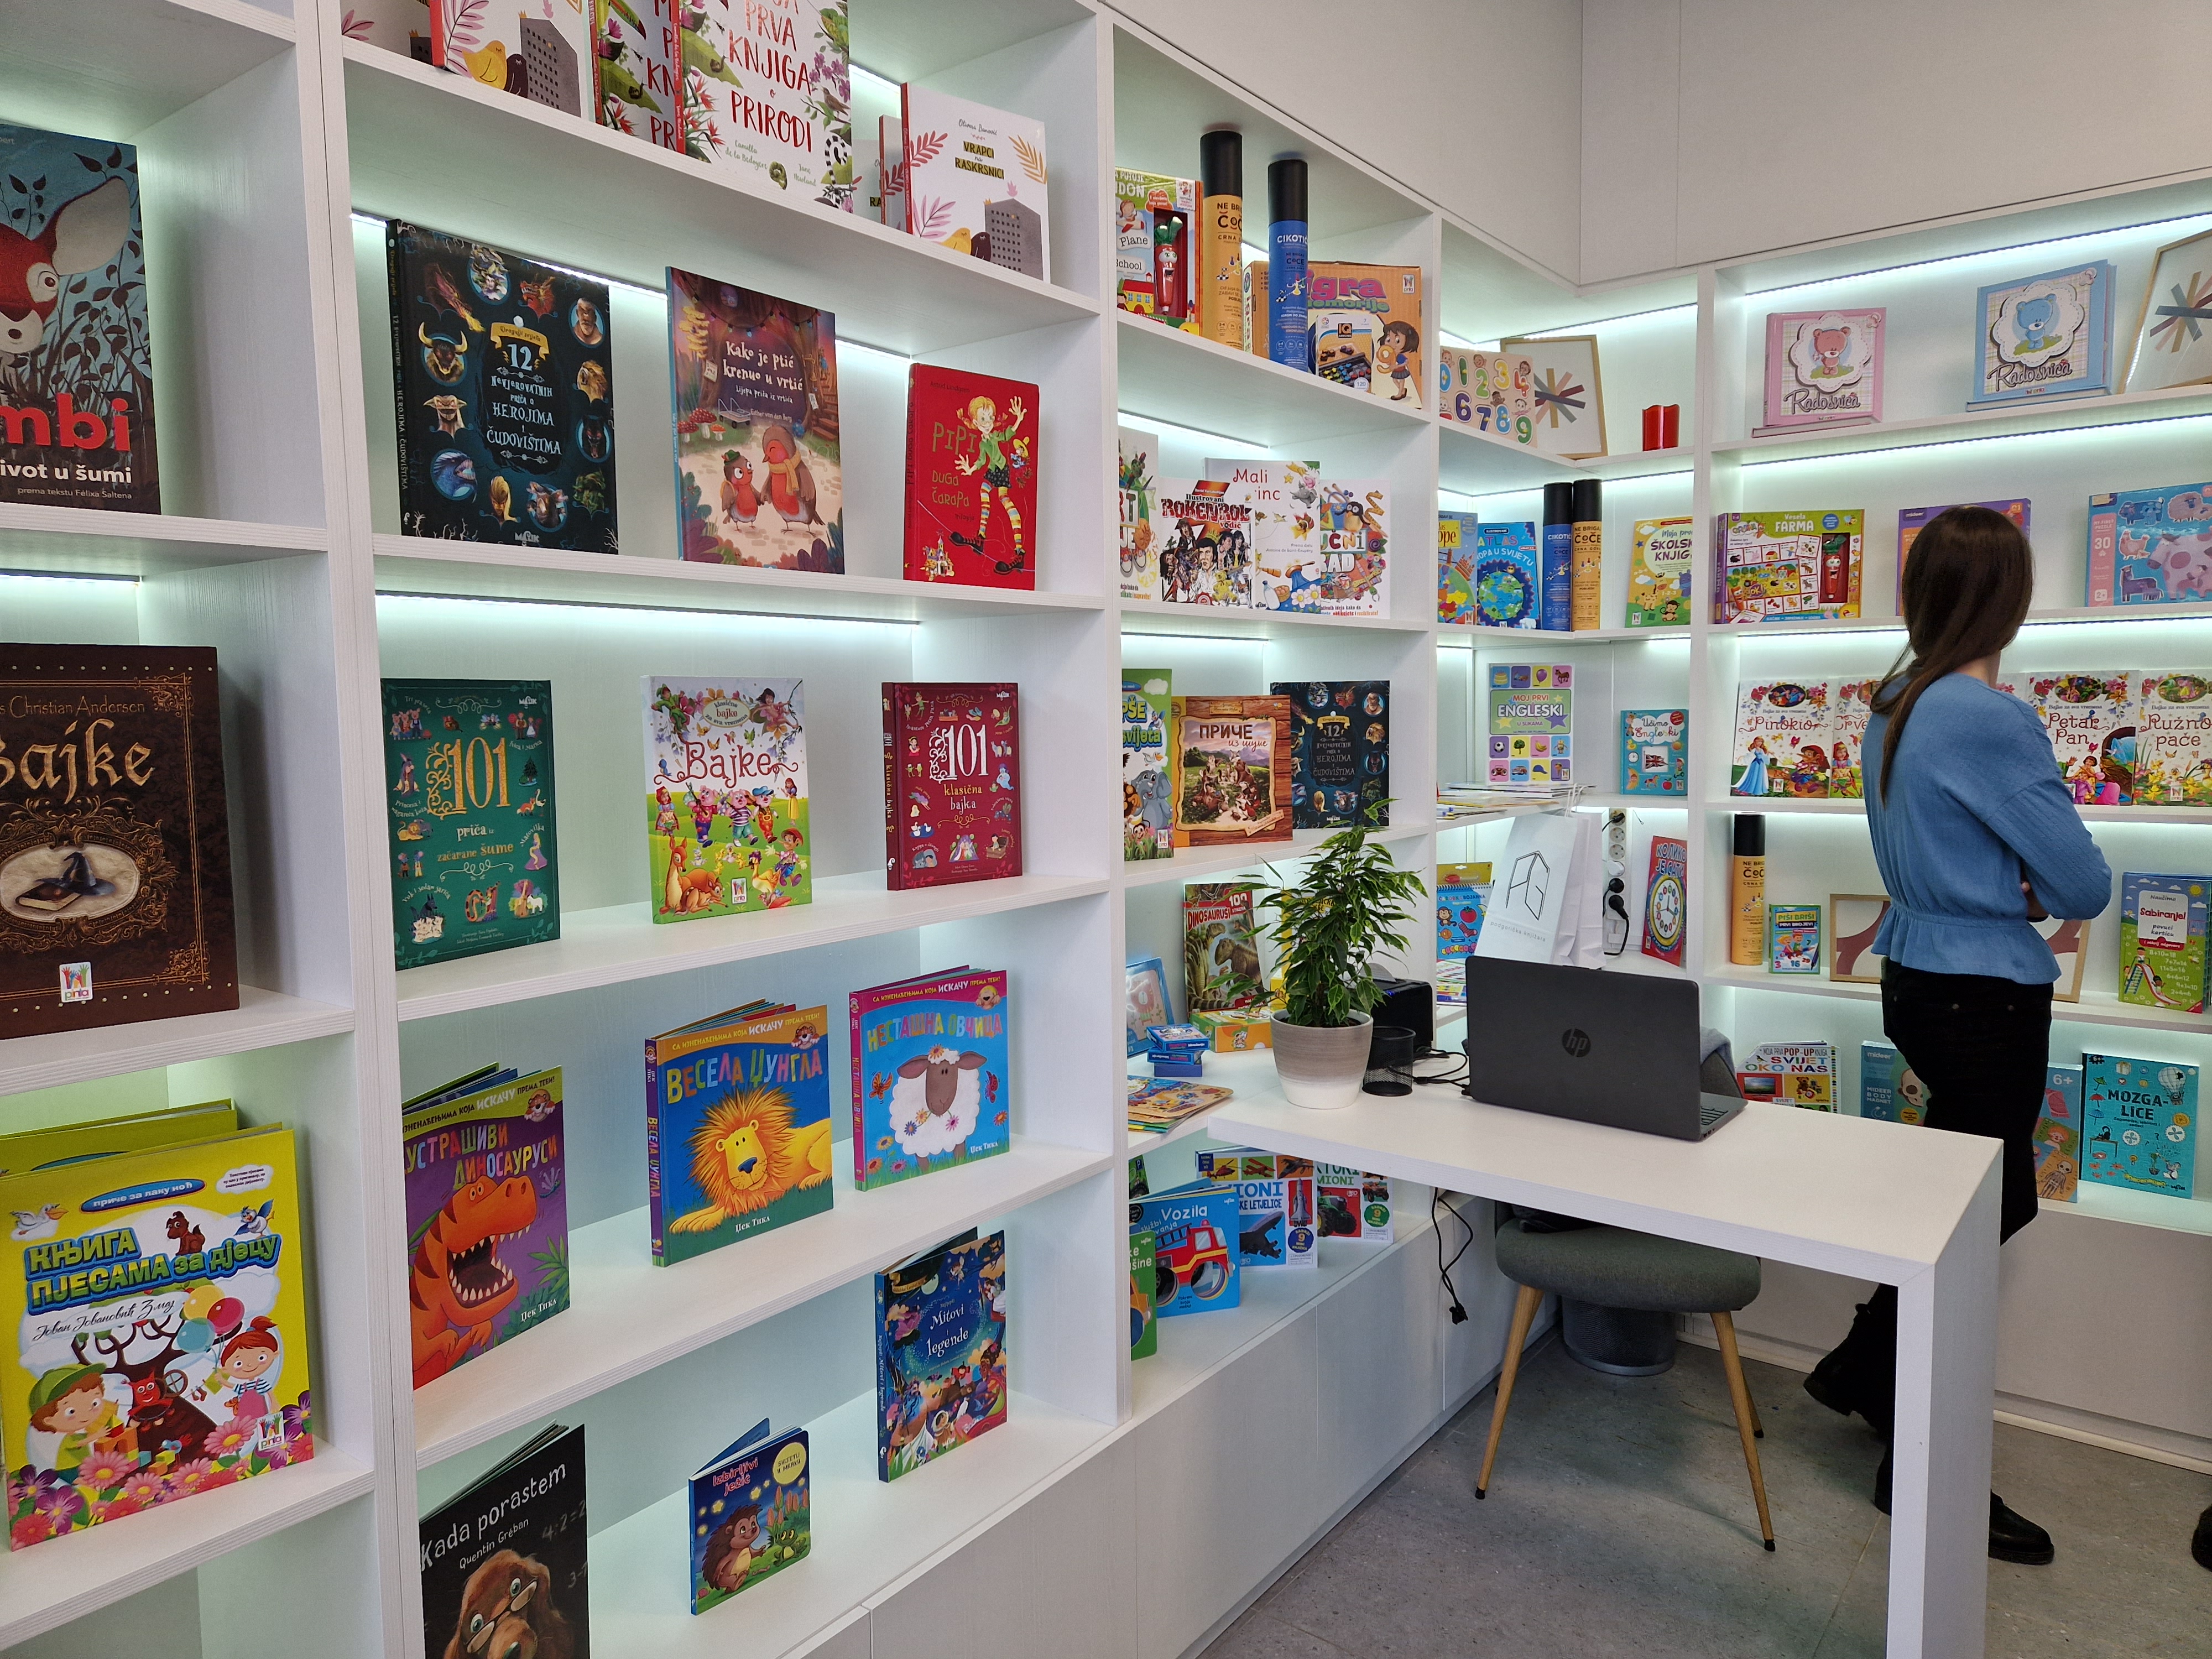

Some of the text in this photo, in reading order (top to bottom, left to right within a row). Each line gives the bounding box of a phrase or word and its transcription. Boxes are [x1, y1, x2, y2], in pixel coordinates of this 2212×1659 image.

[745, 0, 797, 52] PRVA
[729, 29, 811, 96] KNJIGA
[731, 90, 812, 153] PRIRODI
[725, 147, 733, 157] de
[734, 150, 740, 160] la
[734, 139, 758, 154] Camilla
[963, 141, 994, 158] VRAPCI
[799, 163, 811, 174] Jane
[955, 157, 1004, 179] RASKRSNICI
[1120, 171, 1144, 182] PUTUJE
[794, 173, 817, 187] Newland
[1119, 236, 1148, 247] Plane
[500, 325, 523, 338] Dragulji
[1339, 324, 1351, 333] IQ
[508, 343, 533, 371] 12
[726, 341, 794, 371] Kako je ptić
[723, 359, 803, 390] krenuo u vrtić
[1987, 359, 2072, 391] Radosnica
[735, 385, 793, 404] Lijepa priča iz vrtića
[1784, 388, 1860, 414] Radosnica
[493, 402, 555, 426] HEROJIMA
[487, 426, 562, 456] ČUDOVIŠTIMA
[932, 421, 977, 455] PIPI
[55, 465, 132, 483] u šumi
[1233, 468, 1267, 483] Mali
[18, 487, 45, 497] prema
[47, 488, 72, 497] tekstu
[101, 490, 132, 499] Saltena
[1186, 494, 1224, 503] Ilustrovani
[1161, 498, 1251, 523] ROKENROL
[1775, 520, 1814, 533] FARMA
[1478, 535, 1518, 546] ATLAS
[2095, 537, 2111, 549] 30
[1501, 548, 1534, 566] SVIJETU
[1751, 584, 1764, 595] OK!
[9, 695, 145, 718] Christian Andersen
[714, 700, 738, 708] klasične
[716, 707, 738, 718] bajke
[1498, 704, 1564, 717] ENGLESKI
[1642, 718, 1668, 727] Učimo
[1747, 716, 1819, 731] Pinokio
[2046, 713, 2105, 730] Petar
[2139, 713, 2212, 732] Ružno
[1199, 724, 1253, 740] ПРИЧЕ
[1326, 725, 1340, 737] 12
[1635, 726, 1679, 743] Engleski
[2055, 729, 2090, 744] Pan
[1242, 740, 1268, 751] шуме
[2156, 733, 2201, 751] pače
[945, 724, 989, 780] 101
[1317, 754, 1351, 763] HEROJIMA
[672, 740, 785, 789] Bajke
[1313, 767, 1355, 776] ČUDOVIŠTIMA
[447, 737, 511, 814] 101
[944, 784, 983, 796] klasična
[951, 796, 977, 815] bajka
[457, 823, 487, 842] priča
[437, 843, 514, 862] začarane šume
[1656, 843, 1687, 862] КОЛИКО
[1656, 860, 1684, 877] ЈЕ САТИ
[1187, 907, 1231, 932] DINOSAURUSI
[2140, 907, 2186, 921] Sabiranje!
[1490, 920, 1546, 942] podgorička knjižara
[2150, 950, 2176, 958] 8+10=18
[938, 980, 969, 993] ИСКАЧУ
[970, 978, 987, 987] ПРЕМА
[682, 1032, 732, 1049] ИЗНЕНАЂЕЊИМА
[733, 1029, 748, 1038] КОЈА
[749, 1019, 783, 1036] ИСКАЧУ
[785, 1016, 804, 1026] ПРЕМА
[806, 1013, 820, 1021] ТЕБИ!
[867, 1012, 1003, 1052] НЕСТАШНА ОВЧИЦА
[1566, 1031, 1589, 1052] hp
[1771, 1056, 1826, 1065] SVIJET
[1784, 1048, 1814, 1056] POP-UP
[667, 1048, 823, 1104] ВЕСЕЛА ЏУНГЛА
[1745, 1063, 1785, 1072] OKO
[2053, 1074, 2073, 1085] 6+
[459, 1076, 555, 1117] КОЈА ИСКАЧУ ПРЕМА ТЕБИ!
[2108, 1089, 2169, 1107] MOZGA-
[2121, 1105, 2154, 1120] LICE
[648, 1117, 658, 1155] ВЕСЕЛА
[970, 1141, 998, 1155] Џек Тика
[453, 1135, 558, 1191] ДИНОСАУРУСИ
[93, 1181, 193, 1209] приче за лаку ноћ
[1161, 1204, 1208, 1221] Vozila
[1249, 1199, 1282, 1211] LETJELICE
[735, 1215, 770, 1233] Џек Тика
[1141, 1219, 1161, 1232] službi
[28, 1230, 138, 1274] КЊИГА
[30, 1235, 279, 1308] ПЈЕСАМА за дјецу
[521, 1297, 557, 1323] Џек Тика
[930, 1303, 964, 1331] Mitovi
[33, 1322, 71, 1341] Јован
[926, 1327, 969, 1358] legende
[713, 1456, 759, 1487] Izbirljivi
[782, 1459, 801, 1473] MRAKU
[724, 1473, 751, 1496] ježić
[420, 1463, 566, 1572] Kada porastem
[458, 1519, 529, 1569] Quentin Gréban
